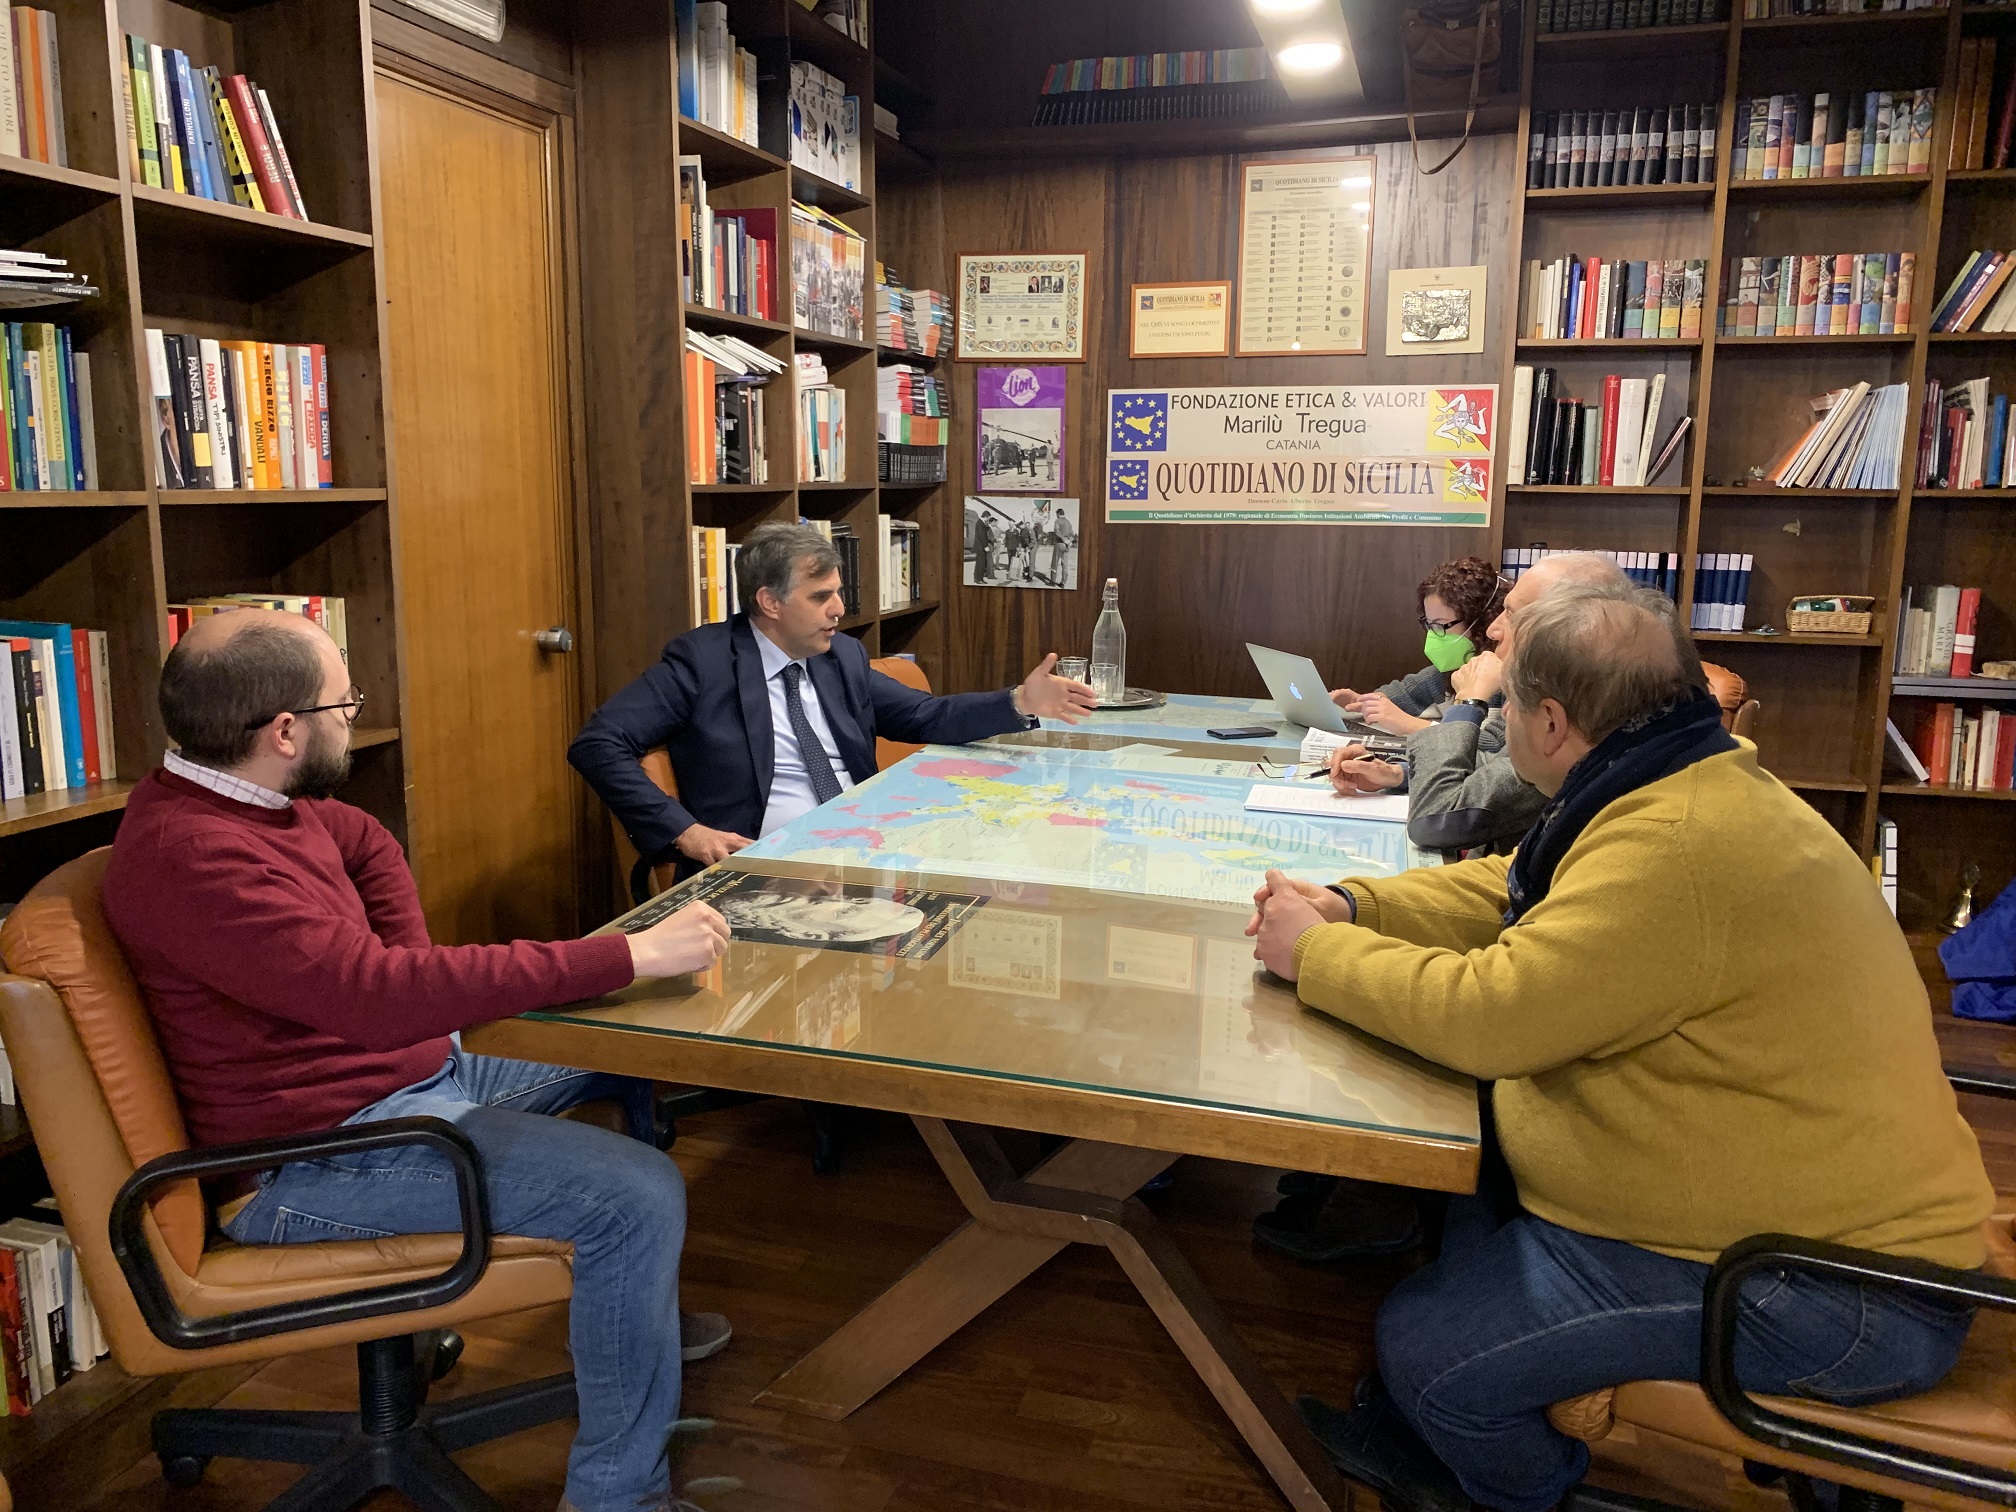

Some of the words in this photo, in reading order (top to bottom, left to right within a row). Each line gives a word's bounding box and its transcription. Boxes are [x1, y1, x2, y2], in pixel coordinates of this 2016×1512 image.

[2, 87, 14, 135] AMORE
[182, 98, 196, 145] FANNULLONI
[224, 106, 236, 130] CORSO
[144, 118, 152, 139] CASTA
[146, 140, 153, 148] LA
[1275, 177, 1311, 186] QUOTIDIANO
[1157, 295, 1184, 305] QUOTIDIANO
[1189, 294, 1205, 303] SICILIA
[1150, 320, 1164, 329] QdS
[188, 356, 201, 398] PANSA
[263, 354, 273, 396] SERGIO
[302, 355, 310, 385] RIZZO
[206, 363, 217, 400] PANSA
[212, 403, 220, 421] TIPI
[319, 383, 328, 407] RIZZO
[1171, 393, 1279, 409] FONDAZIONE
[1285, 392, 1335, 408] ETICA
[1341, 391, 1356, 408] &
[1362, 391, 1426, 408] VALORI
[51, 399, 60, 426] CORSO
[266, 399, 275, 433] RIZZO
[304, 401, 316, 449] CRICCA
[1224, 413, 1282, 434] Marilù
[1296, 412, 1366, 438] Tregua
[254, 420, 265, 464] VANDALI
[321, 419, 331, 458] DERIVA
[1266, 439, 1321, 450] CATANIA
[1156, 462, 1305, 501] QUOTIDIANO
[1311, 462, 1338, 494] DI
[1344, 461, 1435, 494] SICILIA
[1391, 513, 1408, 521] Profit
[1935, 626, 1945, 653] MARE
[1942, 622, 1954, 661] GRANDE
